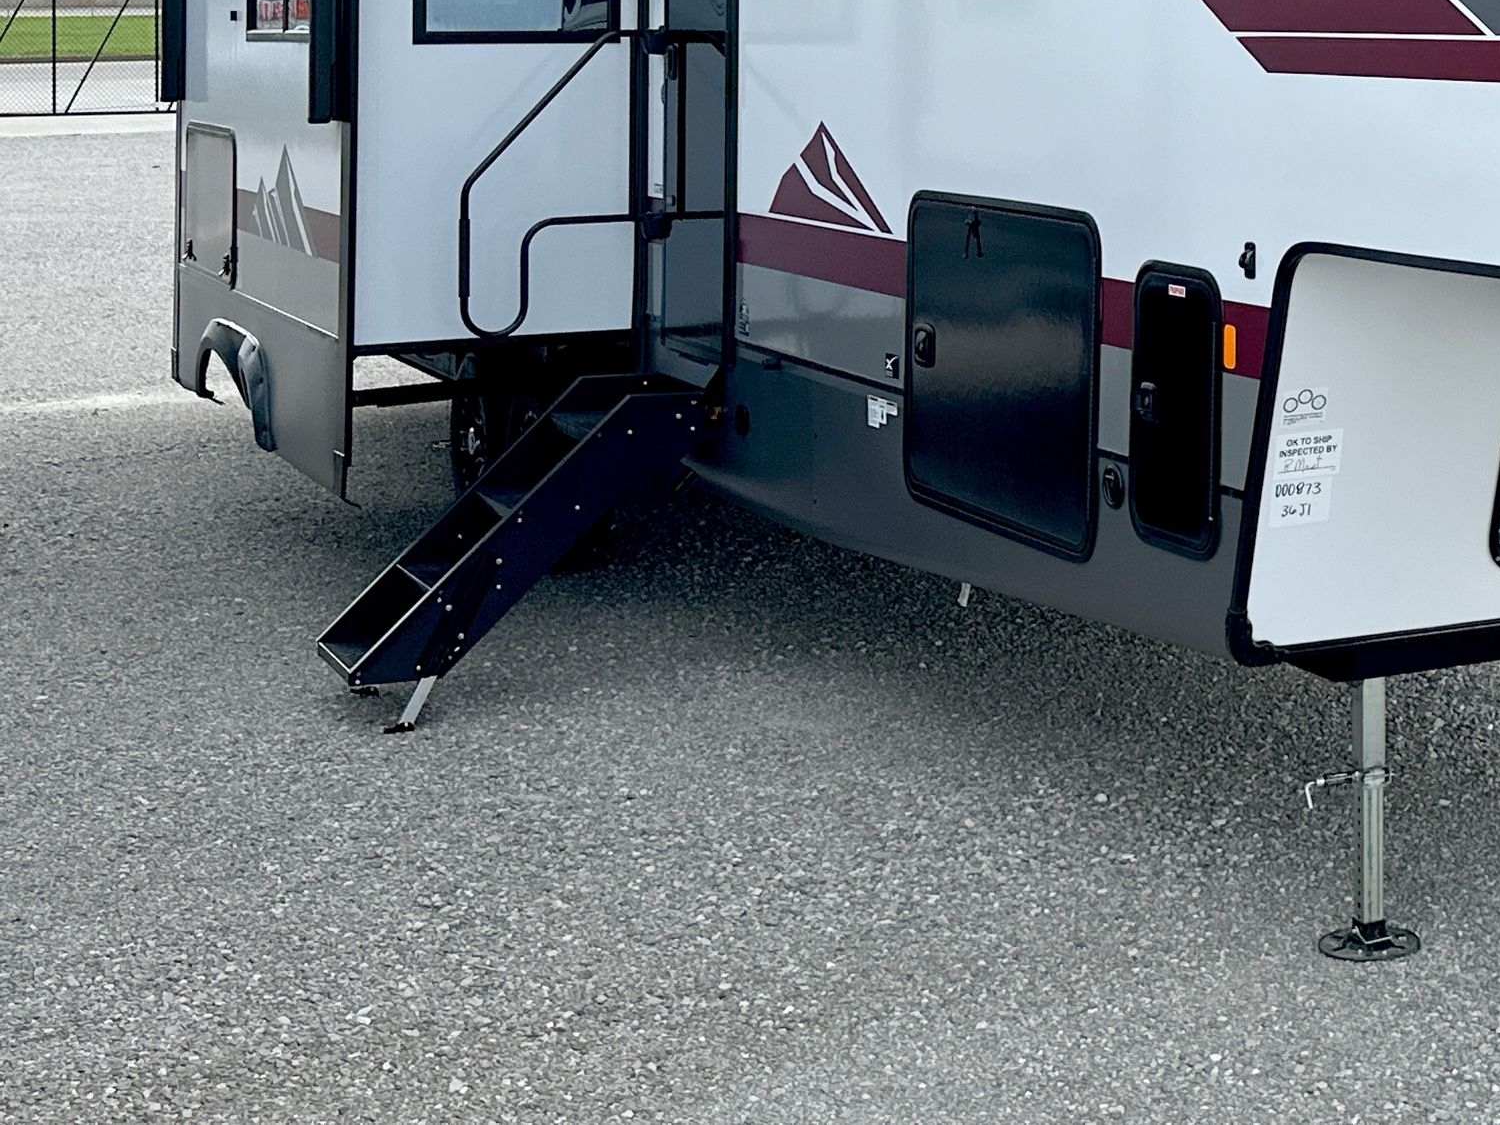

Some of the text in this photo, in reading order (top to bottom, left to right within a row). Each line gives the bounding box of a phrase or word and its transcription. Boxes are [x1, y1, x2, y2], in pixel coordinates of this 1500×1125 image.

[1286, 435, 1332, 447] OK TO SHIP
[1279, 445, 1337, 458] INSPECTED BY
